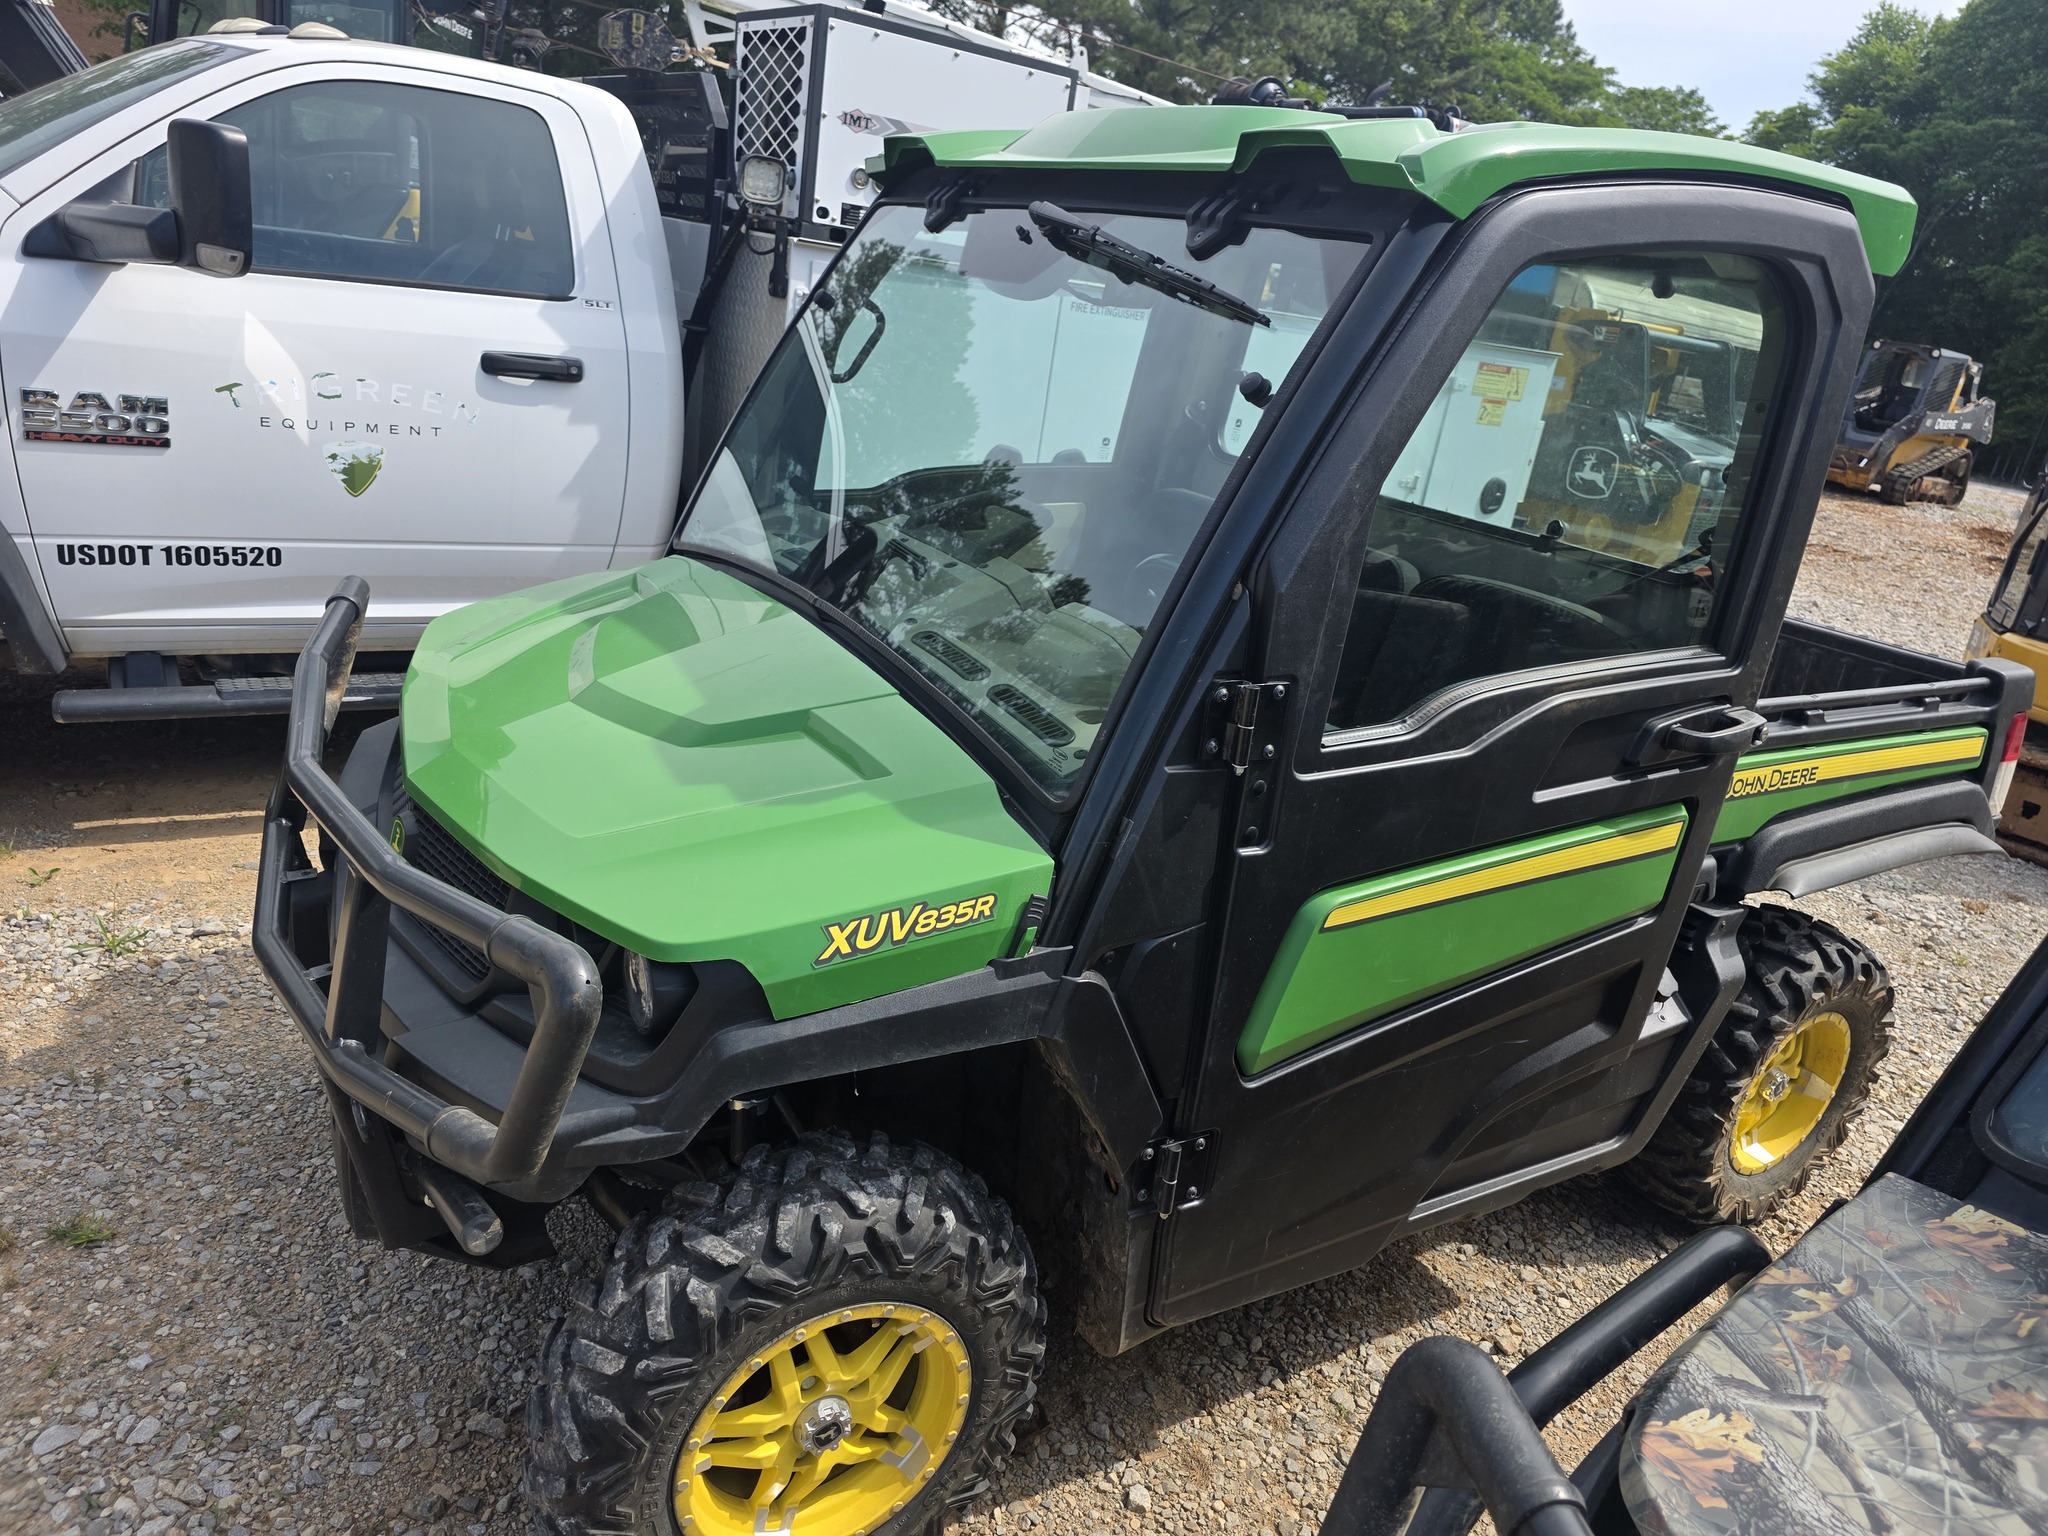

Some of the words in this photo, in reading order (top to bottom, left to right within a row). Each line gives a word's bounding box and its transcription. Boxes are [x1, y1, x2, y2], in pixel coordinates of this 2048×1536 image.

[842, 111, 872, 130] IMT
[585, 300, 612, 309] SLT
[1070, 302, 1089, 314] FIRE
[1089, 305, 1146, 321] EXTINGUISHER
[20, 386, 169, 416] RAM
[214, 372, 481, 428] TRIGREEN
[22, 408, 170, 435] 5500
[260, 416, 442, 437] EQUIPMENT
[29, 431, 103, 443] HEAVY
[106, 435, 166, 446] DUTY
[56, 544, 153, 566] USDOT
[160, 545, 282, 567] 1605520
[1769, 766, 1819, 788] DEERE
[816, 893, 997, 963] XUV835R
